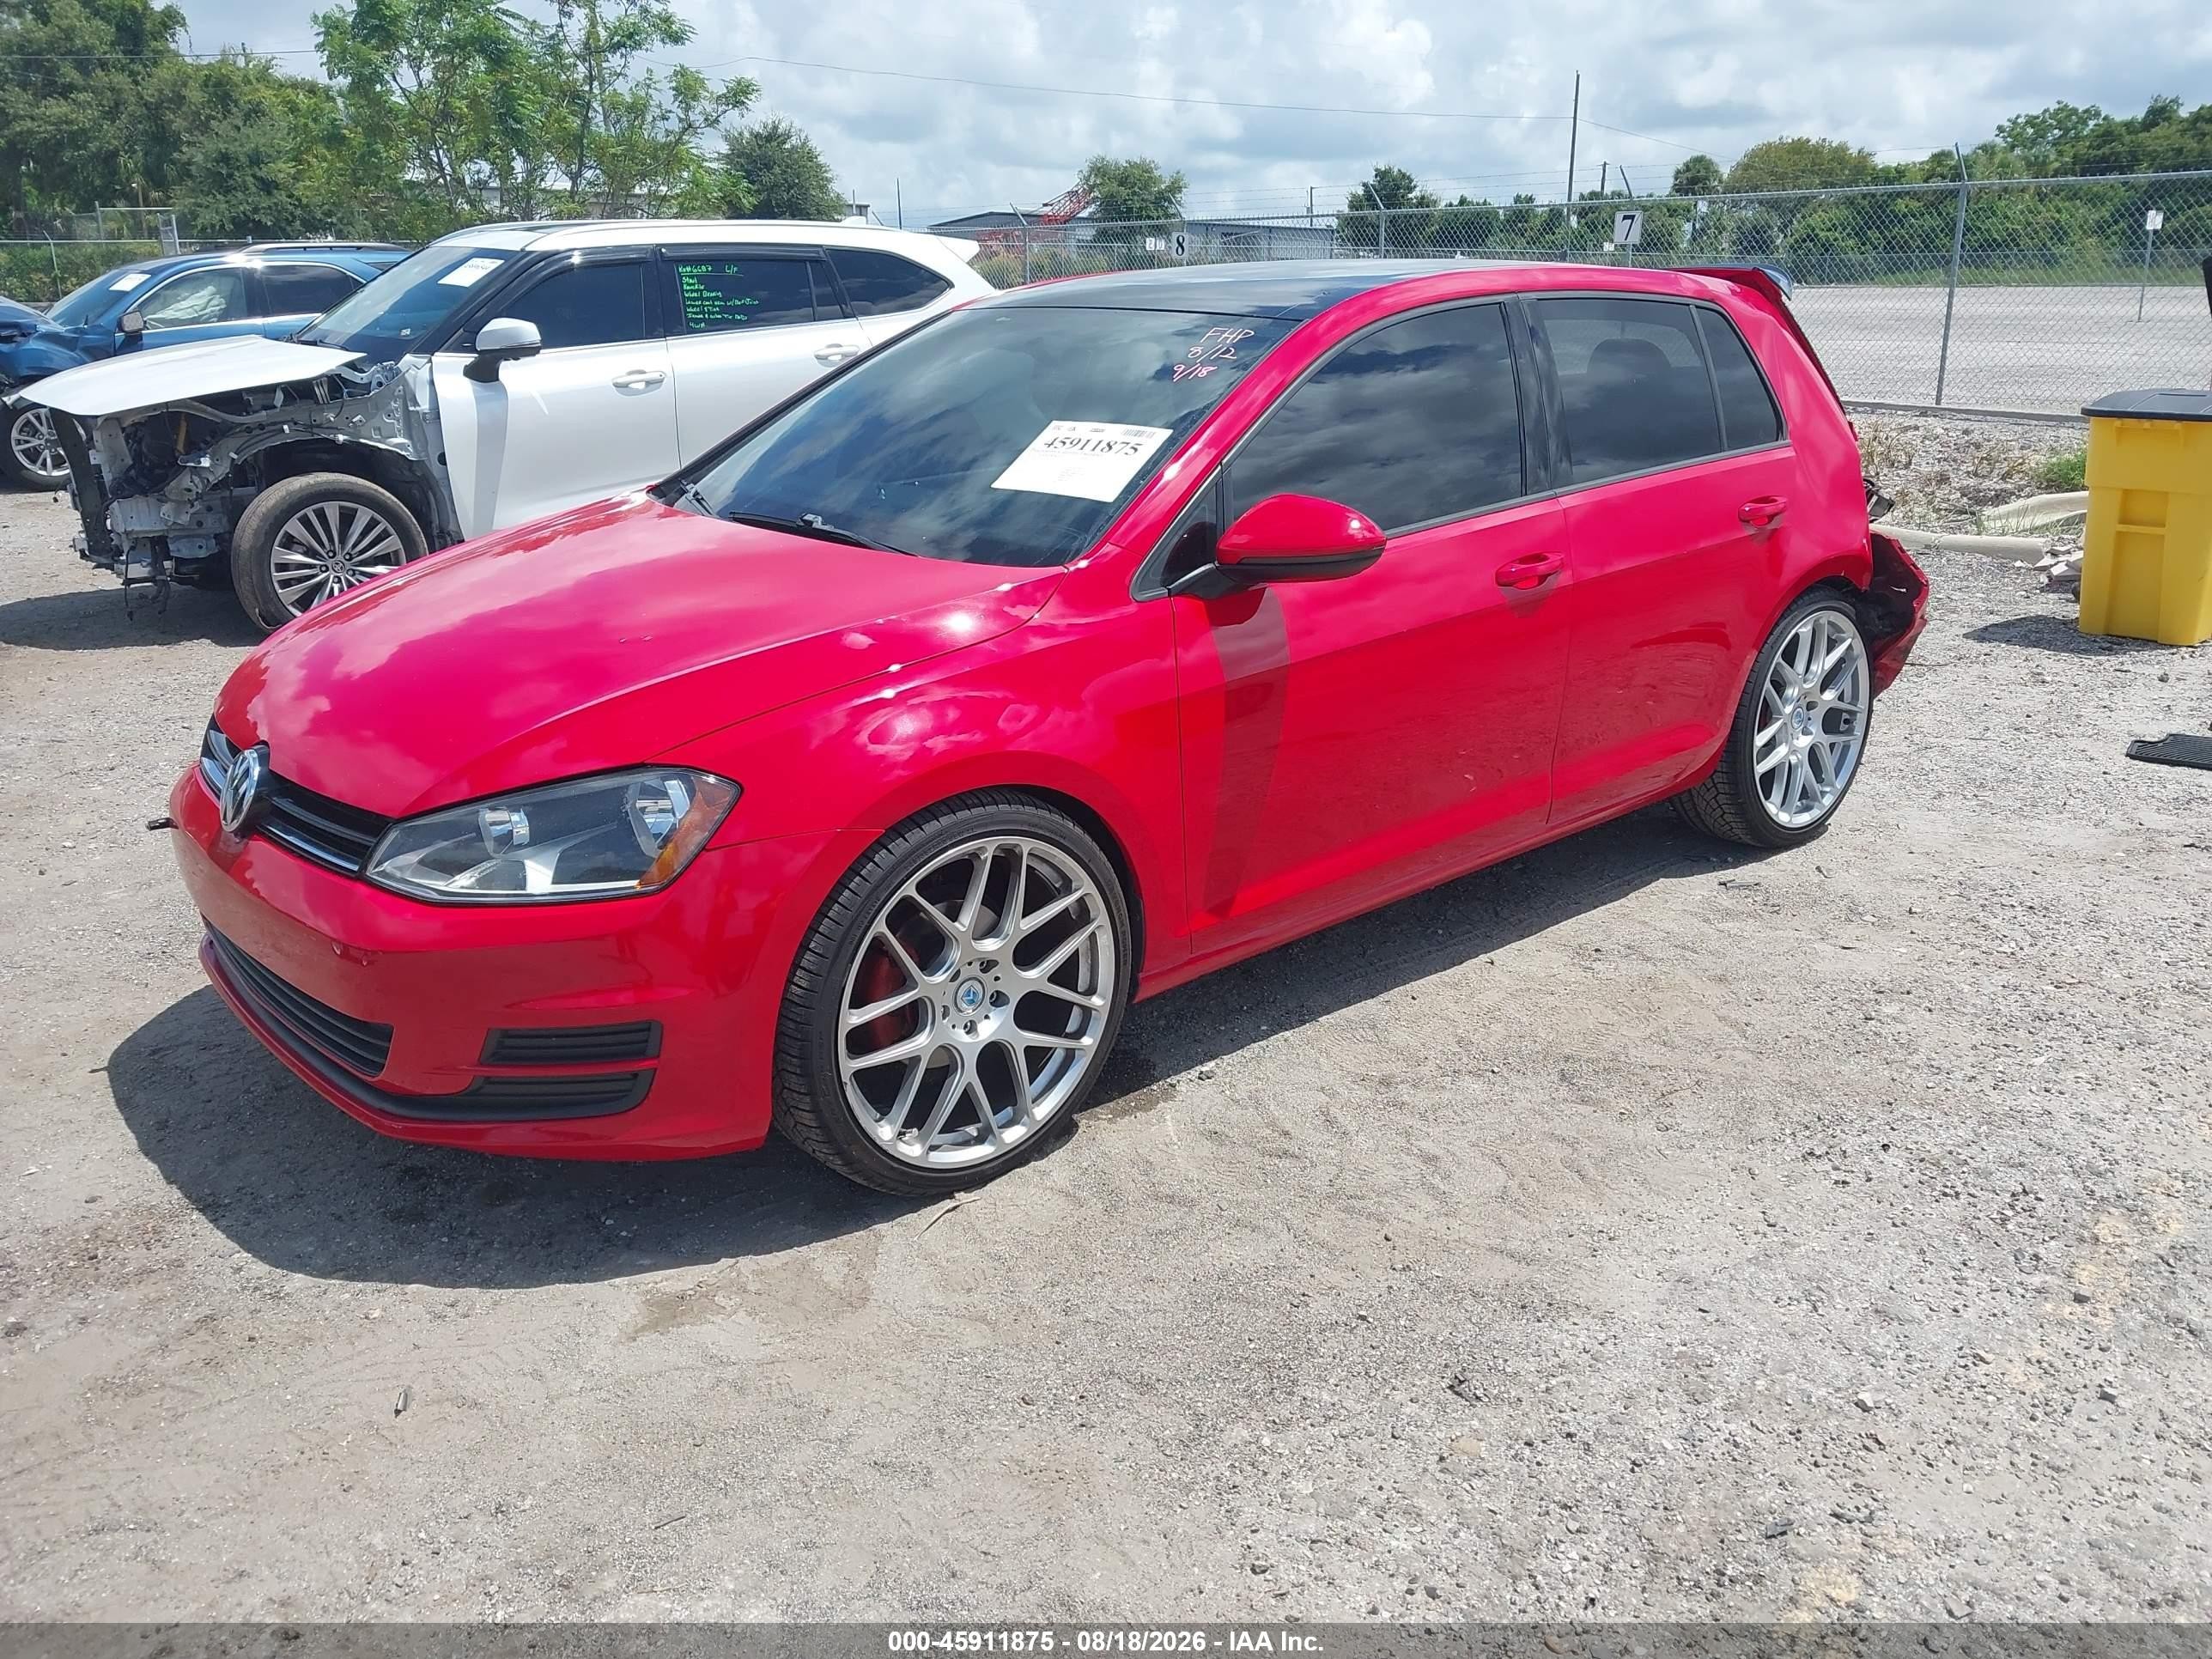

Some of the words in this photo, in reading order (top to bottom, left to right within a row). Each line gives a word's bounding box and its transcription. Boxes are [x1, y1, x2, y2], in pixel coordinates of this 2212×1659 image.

[1620, 214, 1637, 241] 7
[1176, 234, 1185, 256] 8
[1200, 327, 1255, 343] FHP
[1188, 343, 1237, 363] 8/12
[1173, 362, 1218, 382] 9/18
[1043, 436, 1144, 456] 45911875
